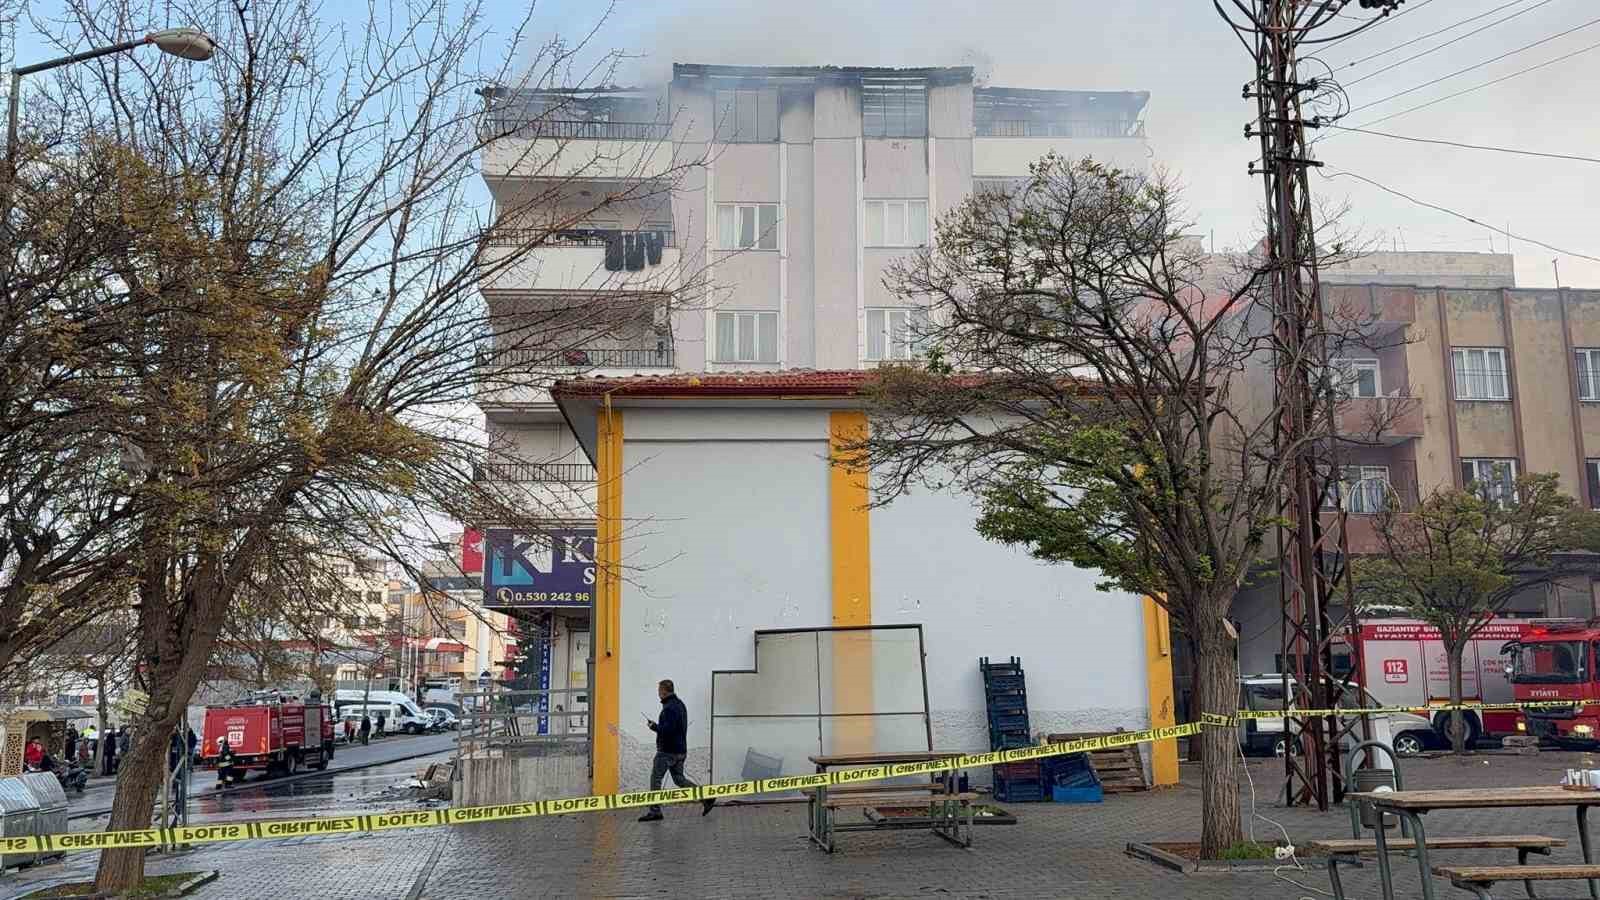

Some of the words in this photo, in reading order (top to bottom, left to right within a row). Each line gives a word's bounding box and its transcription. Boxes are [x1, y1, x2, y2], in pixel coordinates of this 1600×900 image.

[561, 536, 598, 563] K
[515, 592, 547, 601] 0.530
[550, 592, 572, 601] 242
[1386, 661, 1404, 673] 112
